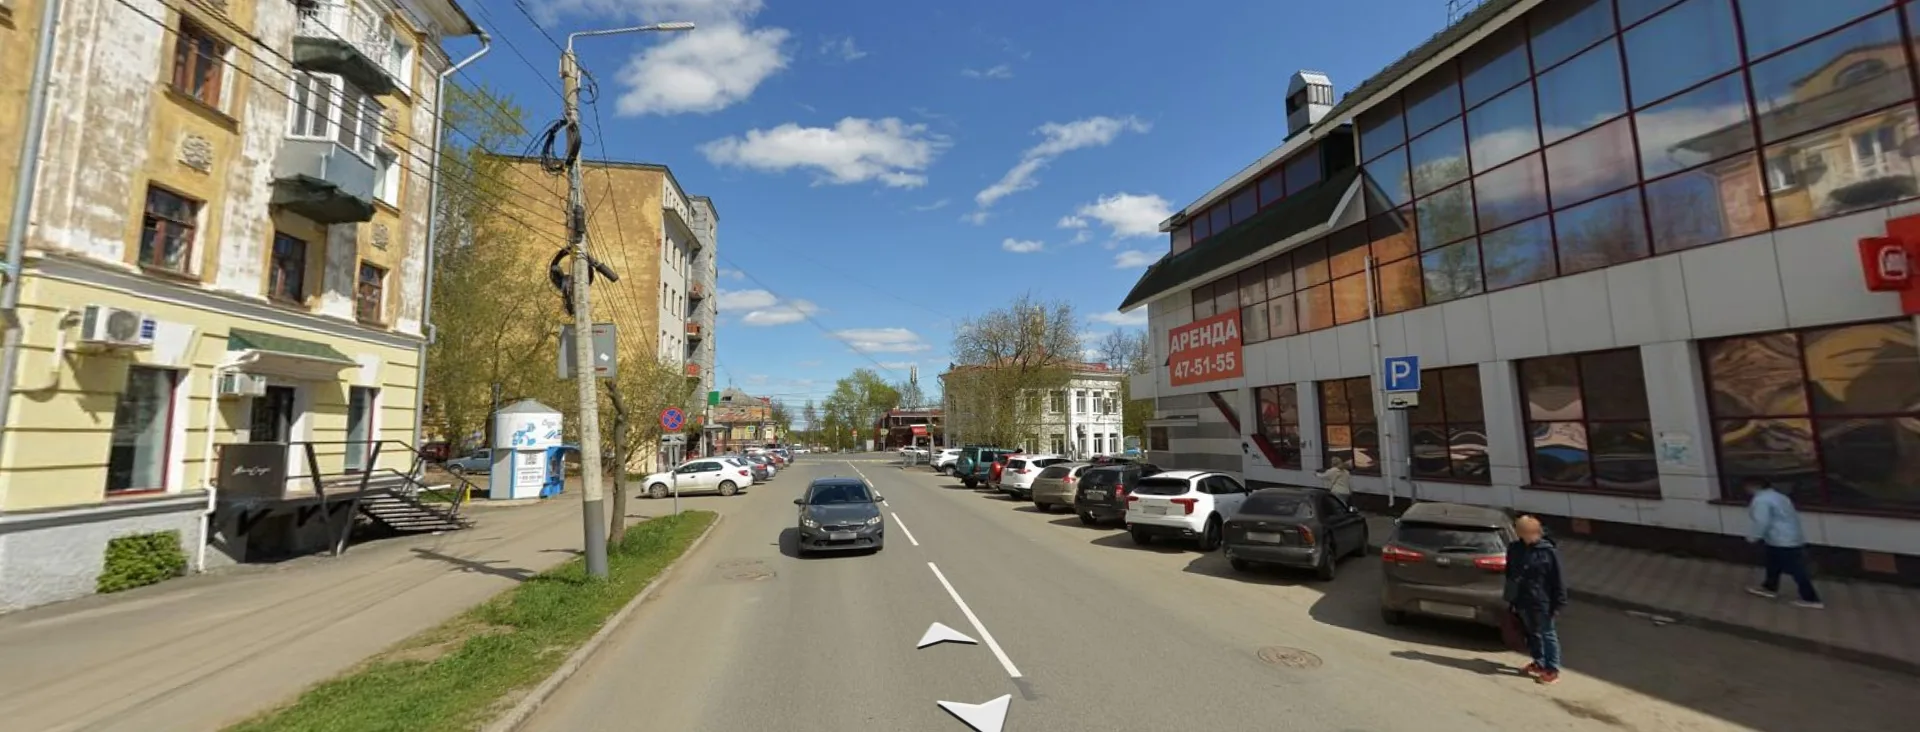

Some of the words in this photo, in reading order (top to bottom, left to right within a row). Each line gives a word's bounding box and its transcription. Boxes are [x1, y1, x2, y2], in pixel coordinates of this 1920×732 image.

[1170, 319, 1238, 354] АРЕНДА
[1174, 351, 1235, 379] 47-51-55
[1391, 360, 1411, 387] P
